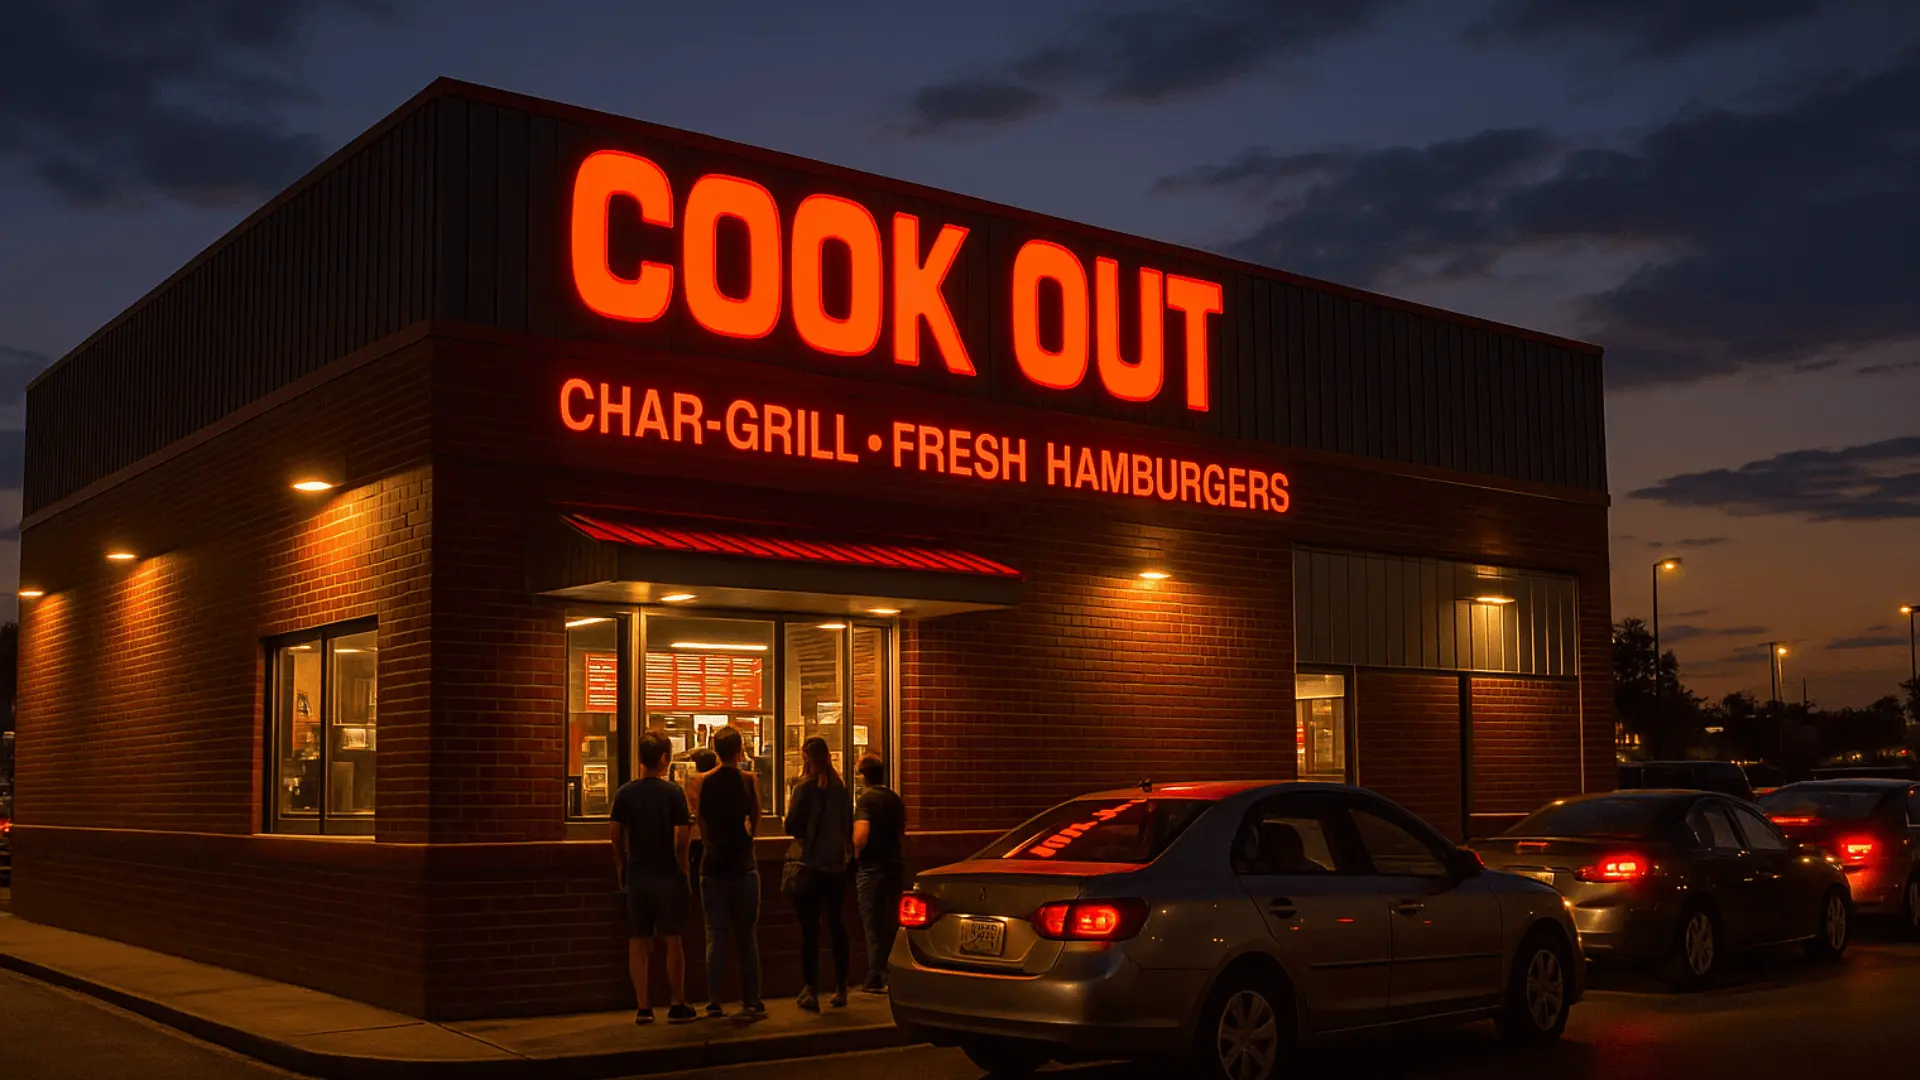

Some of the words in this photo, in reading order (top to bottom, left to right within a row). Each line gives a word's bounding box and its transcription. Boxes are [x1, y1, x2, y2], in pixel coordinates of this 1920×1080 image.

[571, 151, 976, 376] COOK
[1013, 240, 1223, 411] OUT
[560, 378, 859, 463] CHAR-GRILL
[893, 422, 1027, 483] FRESH
[1047, 442, 1290, 513] HAMBURGERS
